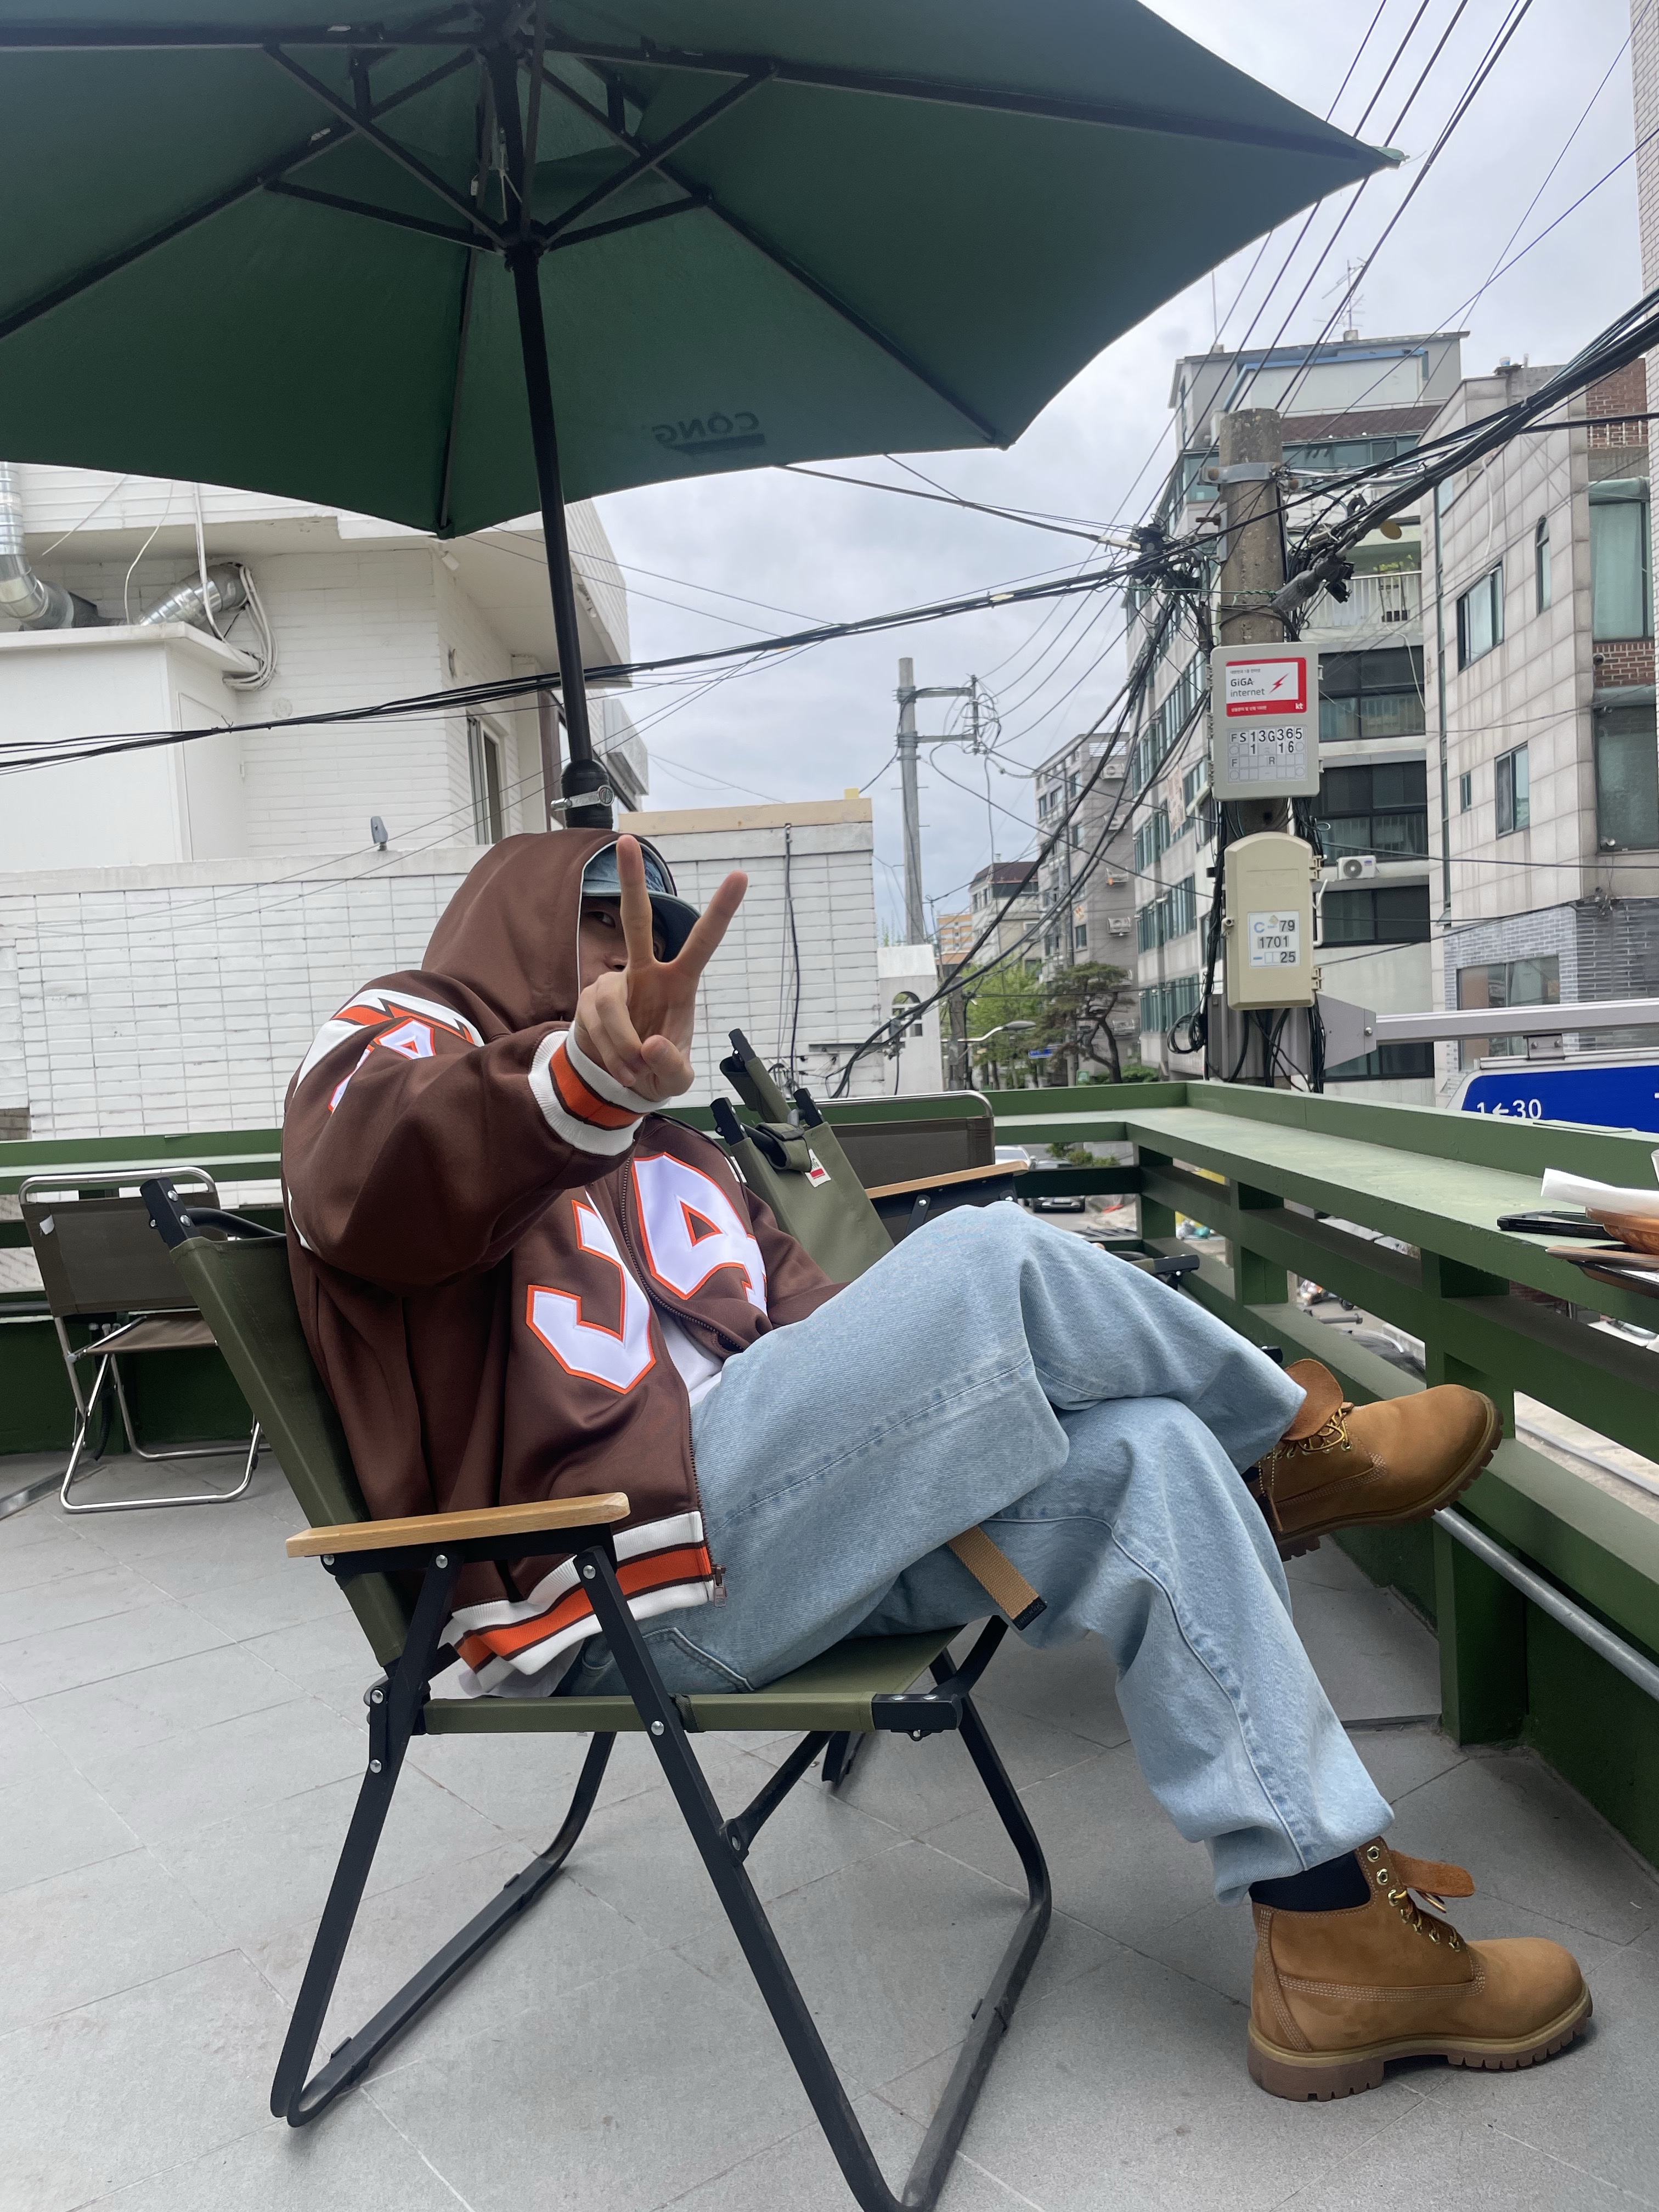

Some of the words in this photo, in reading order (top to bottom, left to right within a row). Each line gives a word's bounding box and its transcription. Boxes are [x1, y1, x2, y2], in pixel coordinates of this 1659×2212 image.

[1231, 678, 1254, 687] GiGA
[1231, 688, 1265, 697] internet
[1232, 758, 1238, 767] F
[1269, 757, 1275, 765] R
[1259, 936, 1289, 948] 1701
[1513, 1098, 1542, 1120] 30
